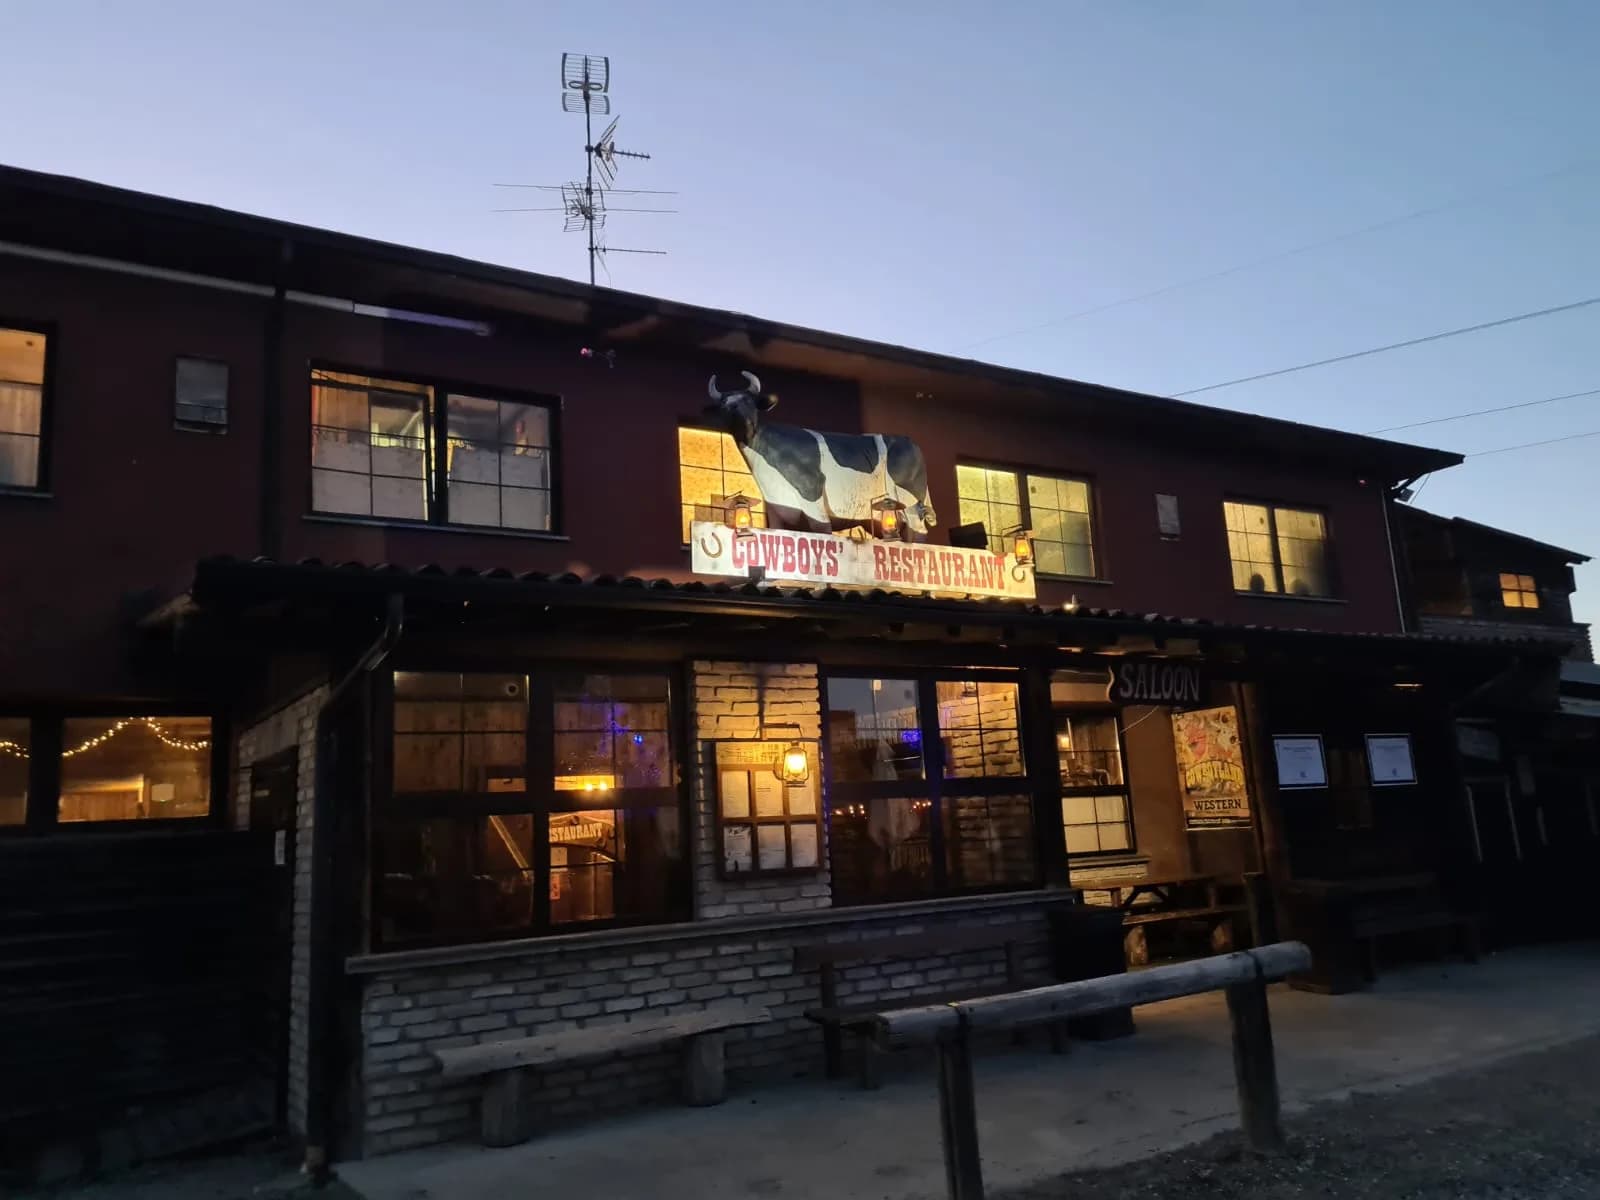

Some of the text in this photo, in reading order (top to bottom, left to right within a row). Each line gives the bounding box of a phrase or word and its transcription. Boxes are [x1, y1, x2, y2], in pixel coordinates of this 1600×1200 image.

[731, 530, 1006, 590] COWBOYS' RESTAURANT
[1120, 663, 1201, 702] SALOON
[1192, 799, 1242, 810] WESTERN
[549, 822, 603, 842] STAURANT
